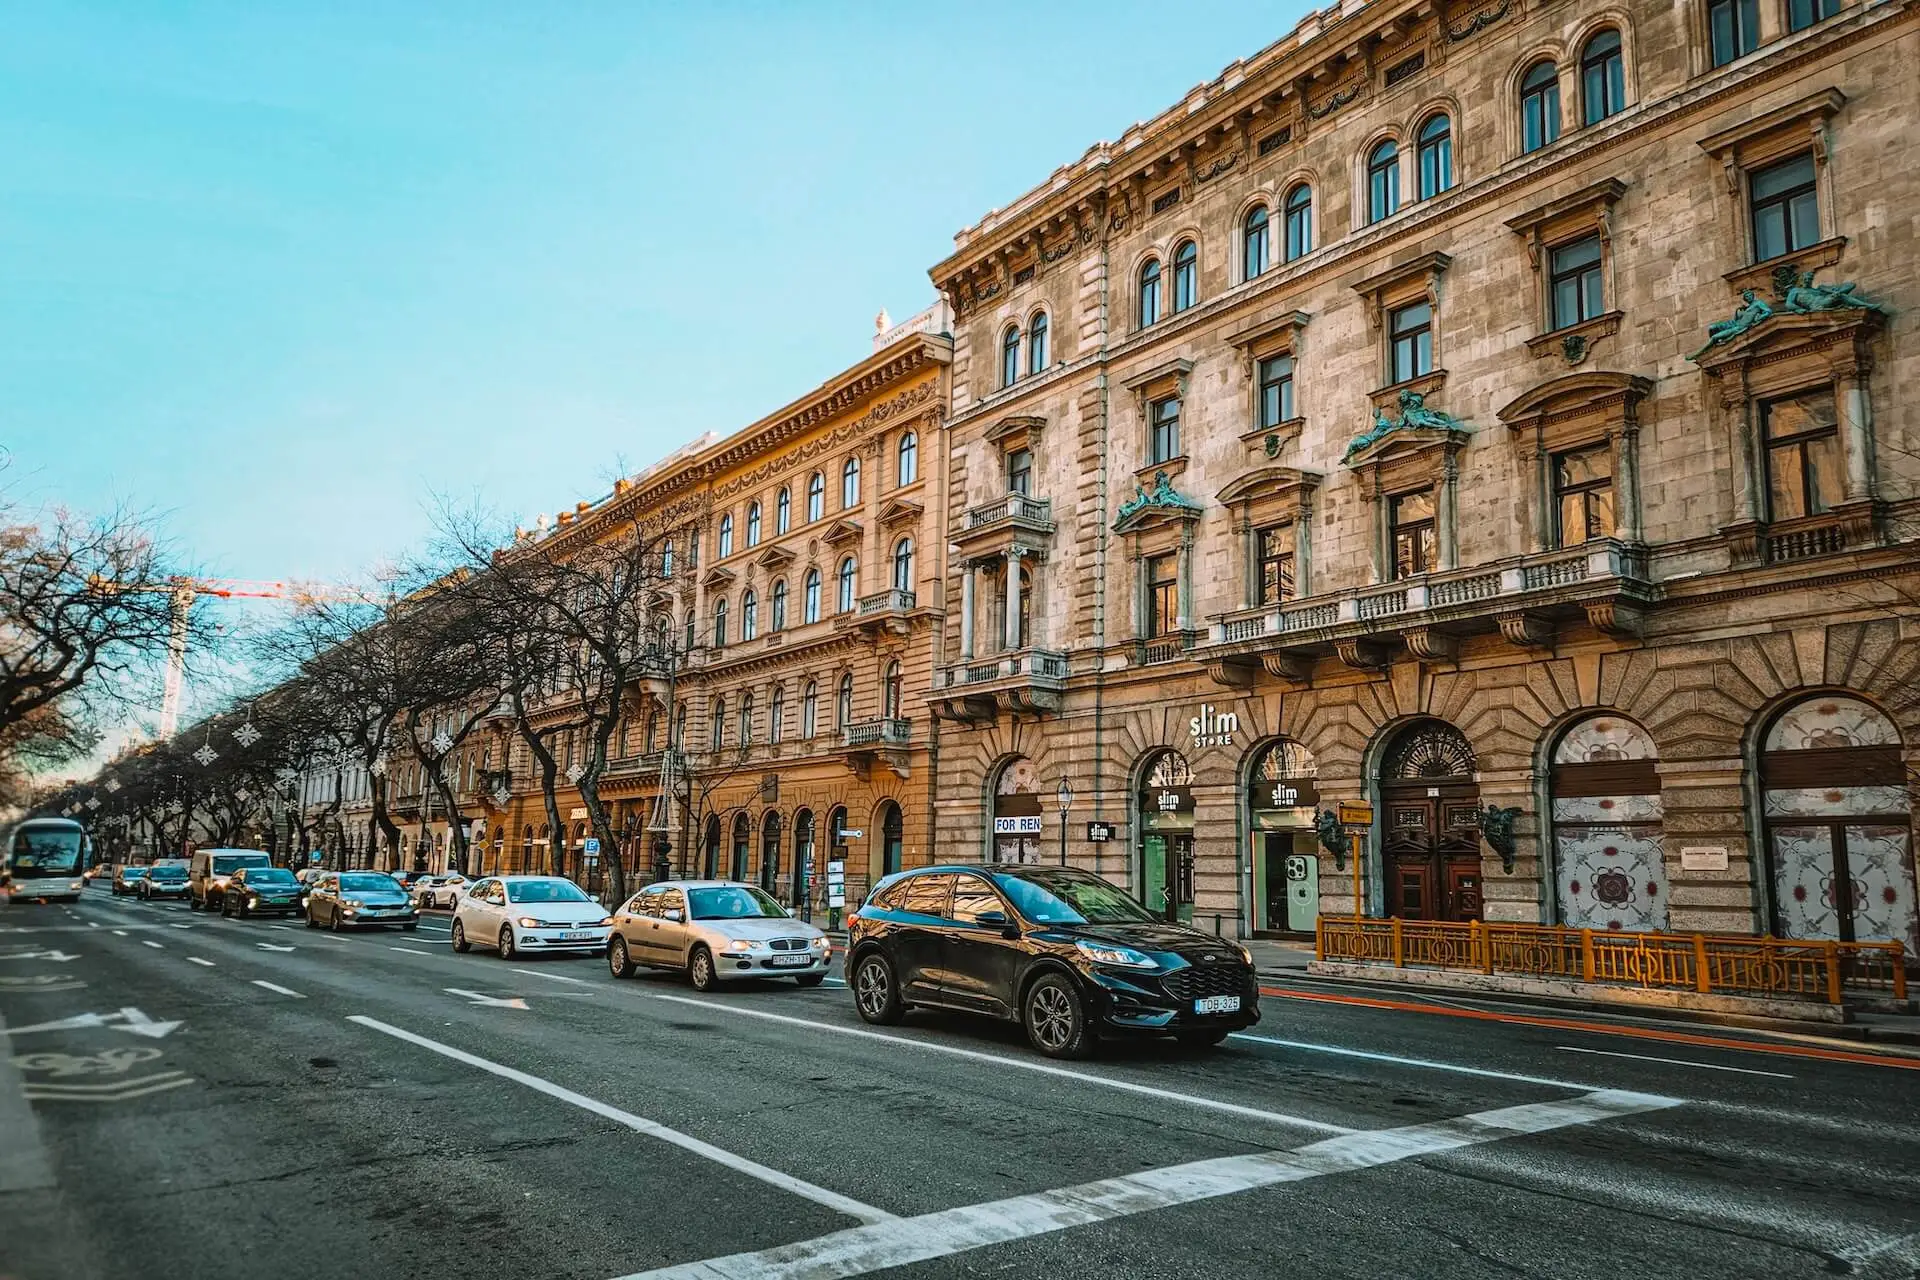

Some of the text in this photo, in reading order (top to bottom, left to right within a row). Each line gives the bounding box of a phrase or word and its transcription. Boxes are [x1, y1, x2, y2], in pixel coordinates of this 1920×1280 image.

[1190, 703, 1238, 736] slim
[1158, 789, 1179, 805] slim
[1271, 783, 1298, 800] slim
[996, 818, 1041, 831] FOR REN
